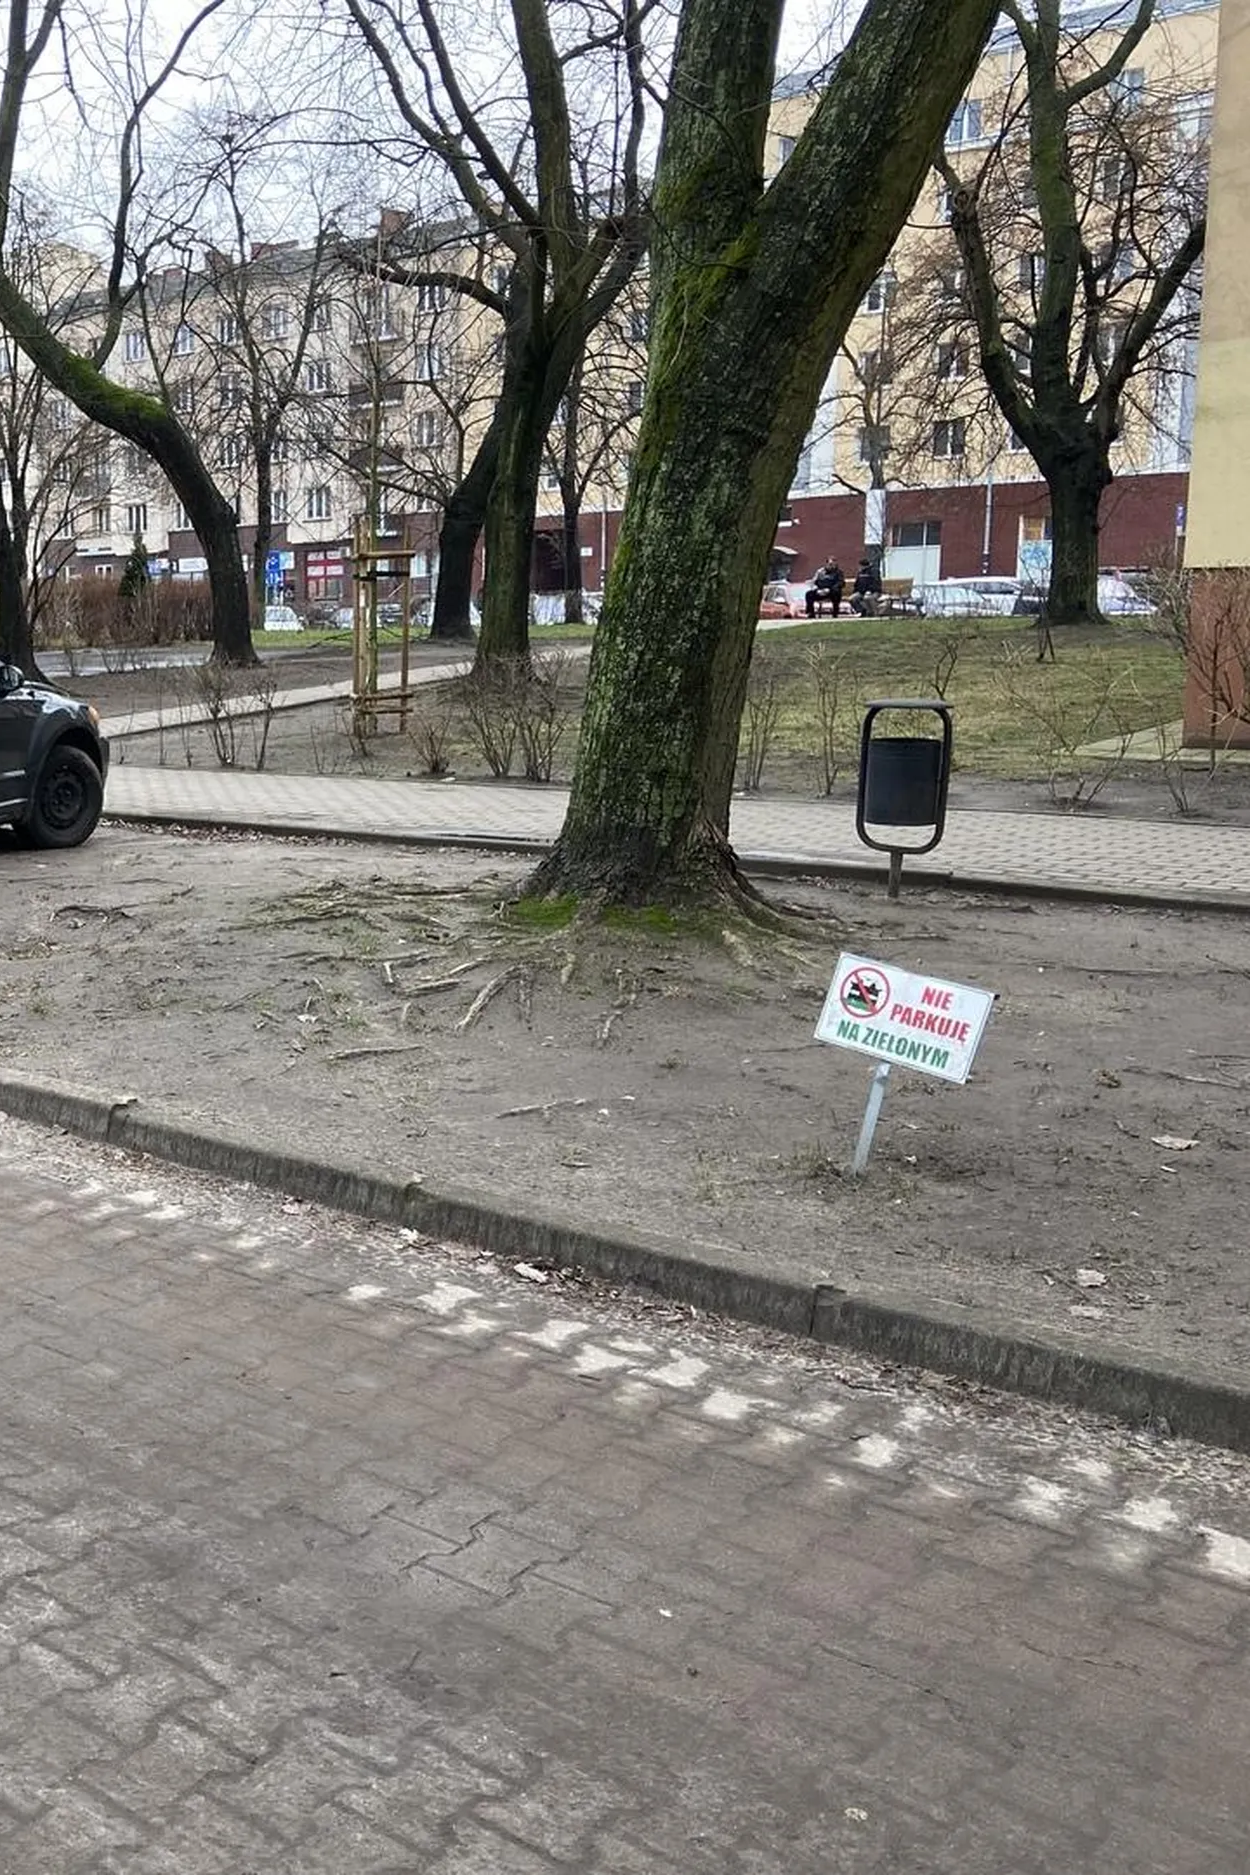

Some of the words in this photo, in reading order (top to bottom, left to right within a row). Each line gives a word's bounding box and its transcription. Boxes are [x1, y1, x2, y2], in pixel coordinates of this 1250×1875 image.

[922, 986, 954, 1011] NIE
[890, 1004, 971, 1042] PARKUJE
[837, 1019, 859, 1042] NA
[862, 1027, 949, 1069] ZIELONYM
